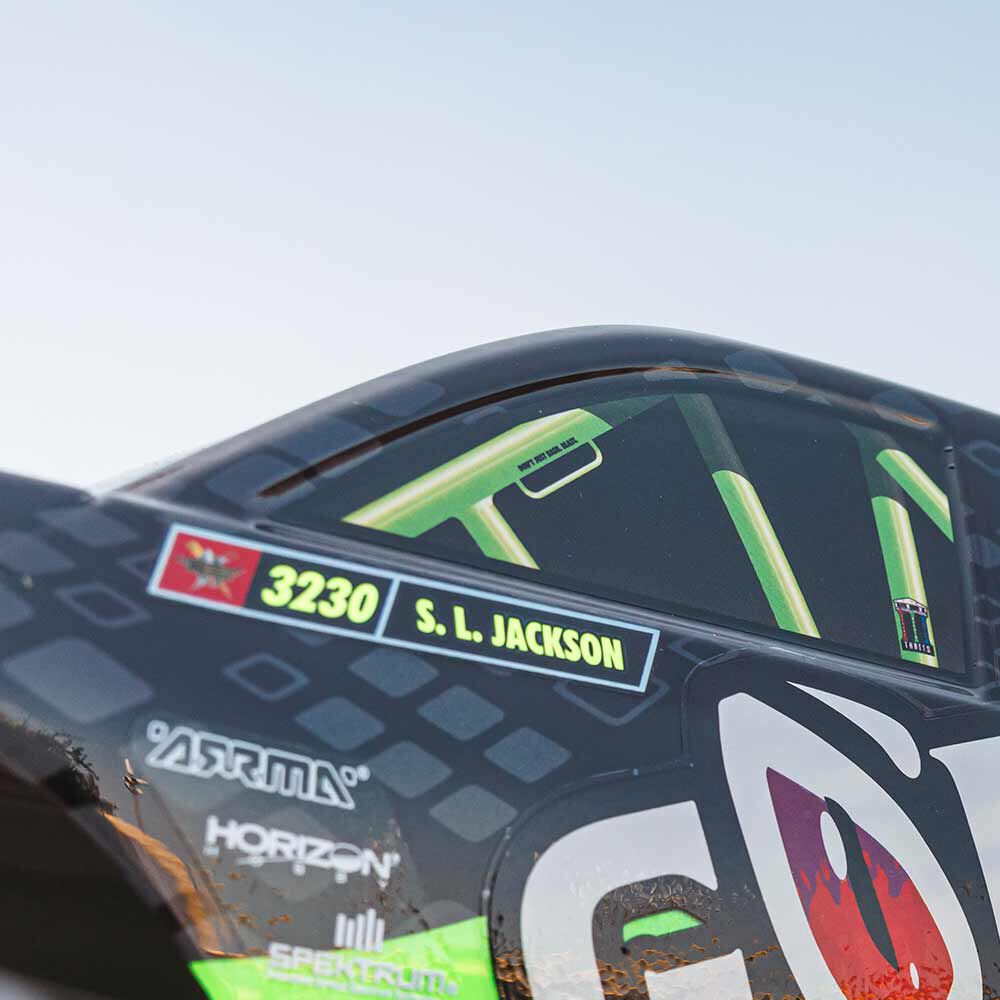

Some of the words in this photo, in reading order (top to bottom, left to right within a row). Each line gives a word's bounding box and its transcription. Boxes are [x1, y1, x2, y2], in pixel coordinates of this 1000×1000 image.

[260, 564, 380, 624] 3230
[415, 598, 447, 637] S.
[454, 605, 483, 643] L.
[491, 613, 625, 670] JACKSON
[204, 815, 396, 880] HORIZON
[268, 941, 452, 996] SPEKTRUM
